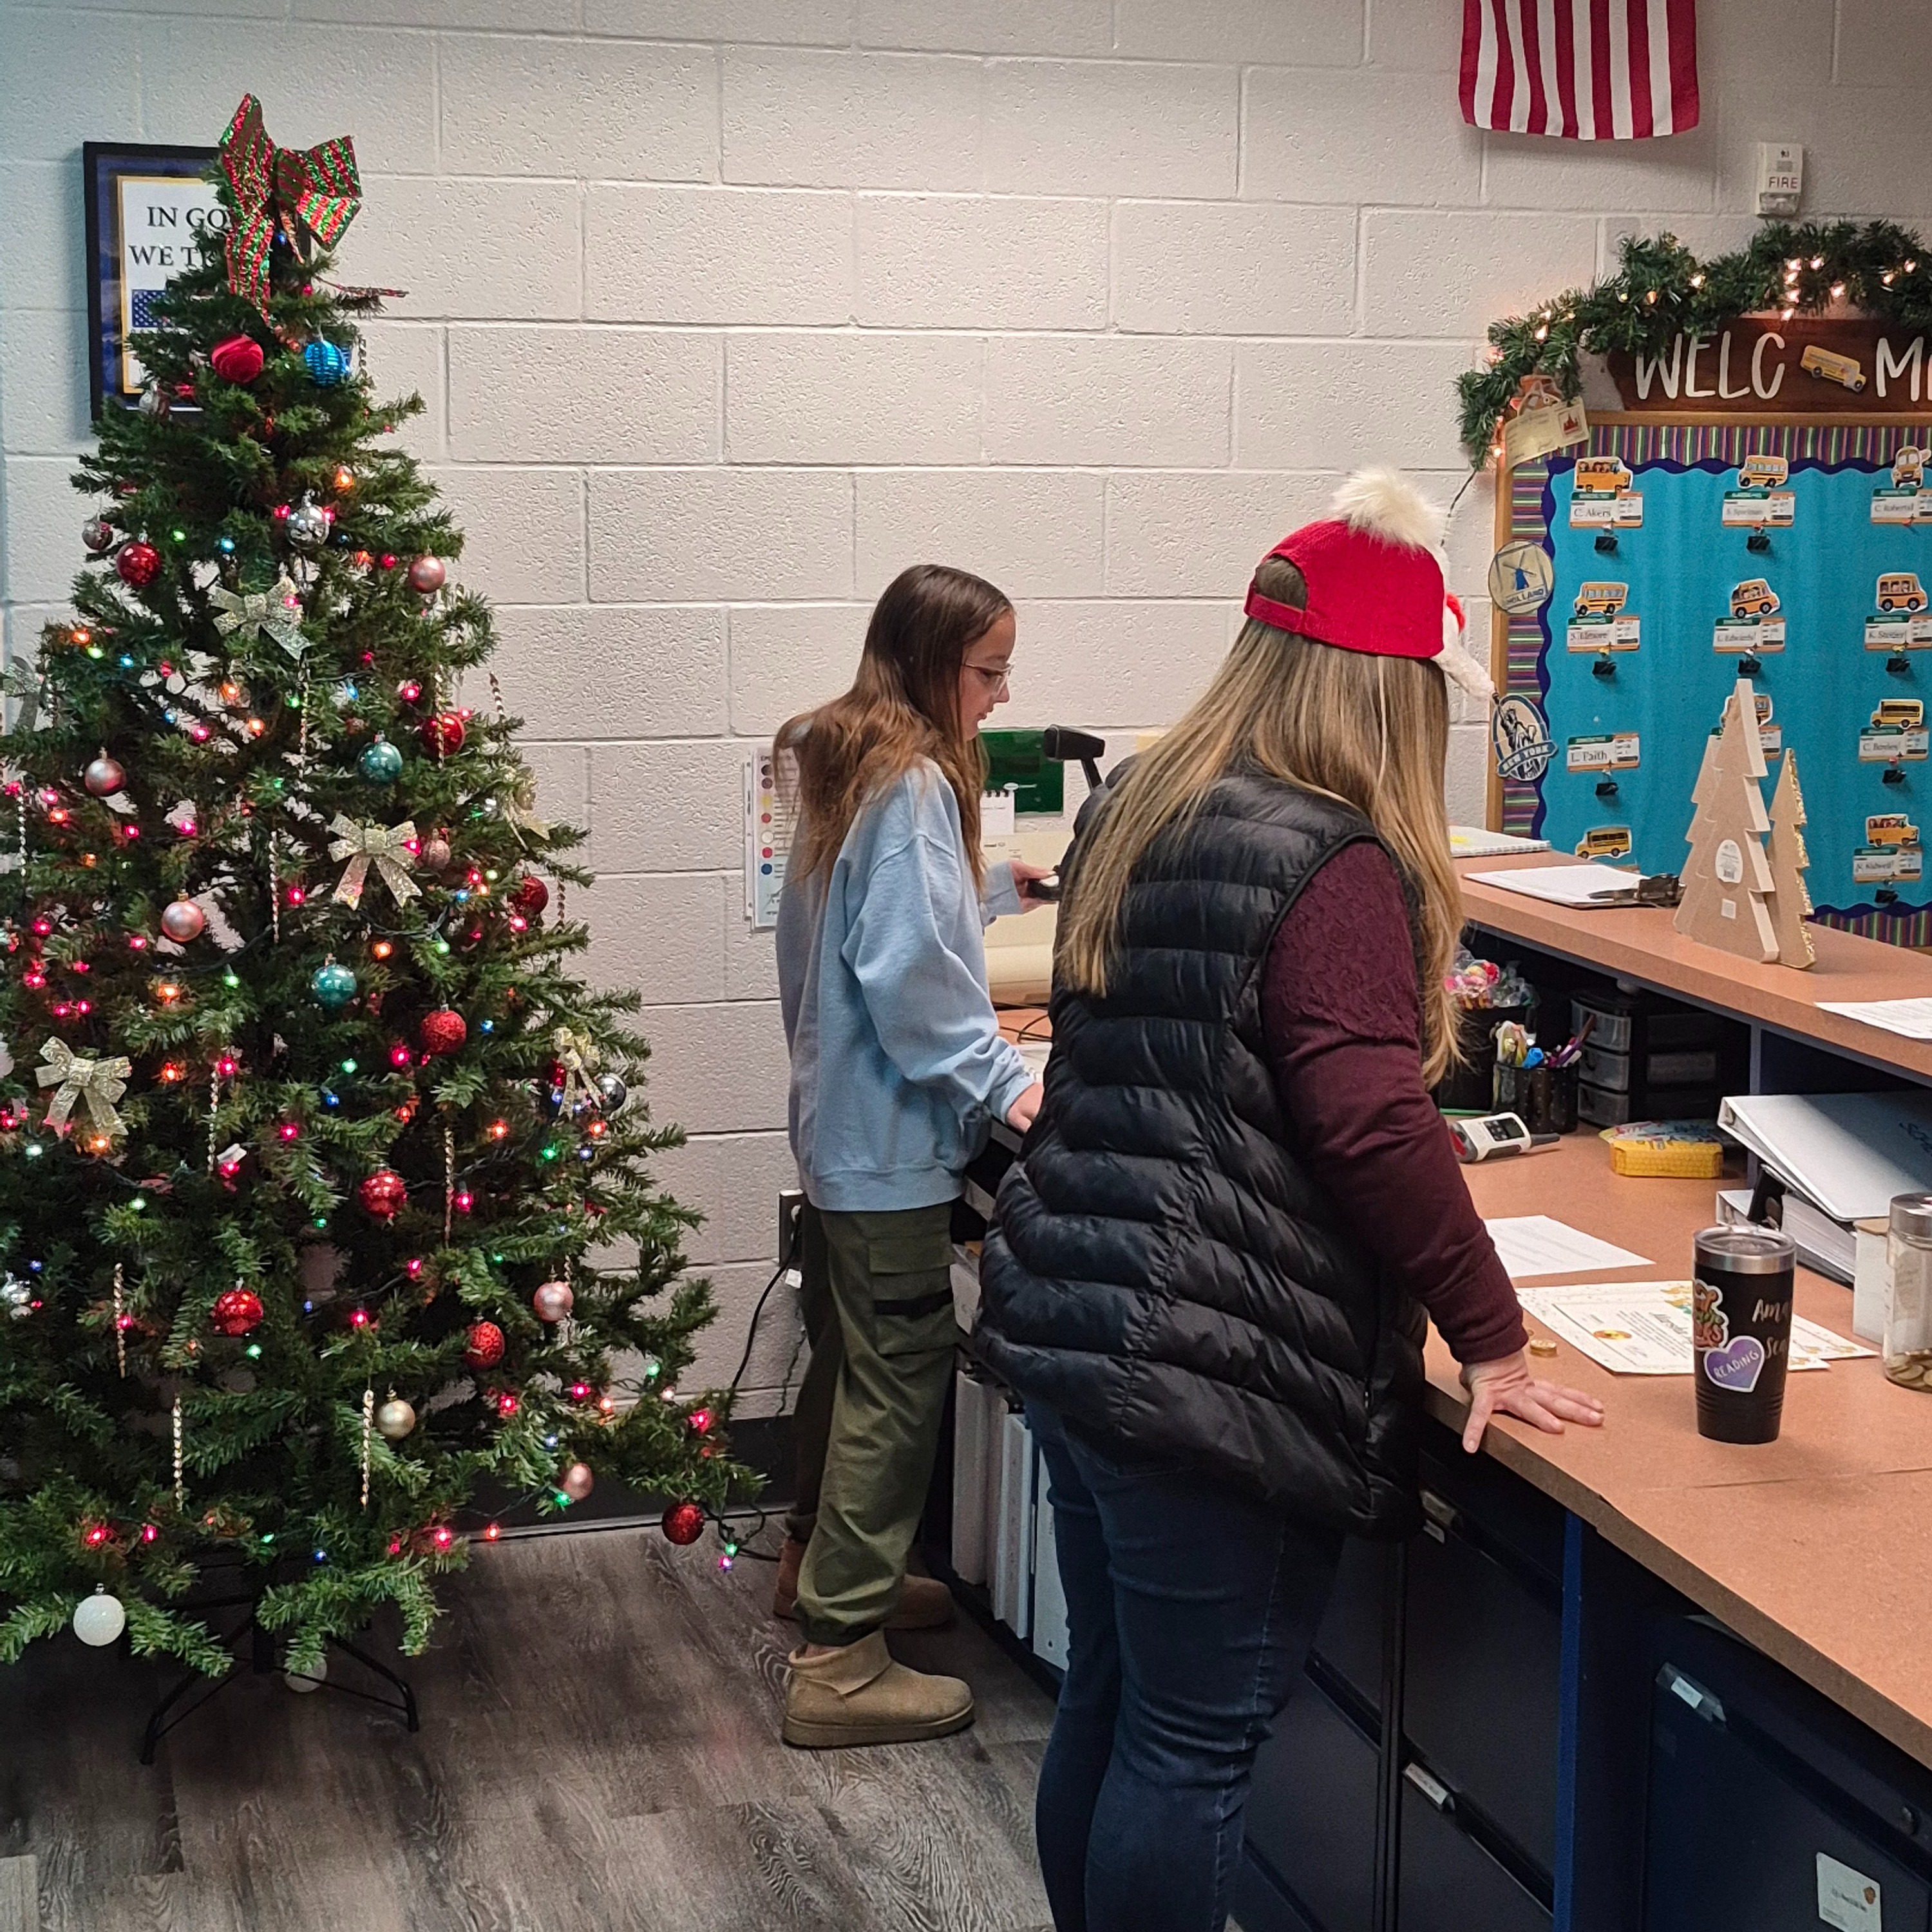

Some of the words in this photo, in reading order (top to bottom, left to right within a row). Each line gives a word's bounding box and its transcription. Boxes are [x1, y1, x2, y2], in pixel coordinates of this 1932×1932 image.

[1768, 176, 1798, 189] FIRE
[146, 206, 178, 227] IN
[185, 207, 227, 229] GO
[128, 245, 174, 266] WE
[1875, 336, 1932, 402] M
[1586, 507, 1611, 518] Akers
[1522, 743, 1549, 759] YORK
[1583, 750, 1608, 762] Faith
[1713, 1350, 1759, 1378] READING
